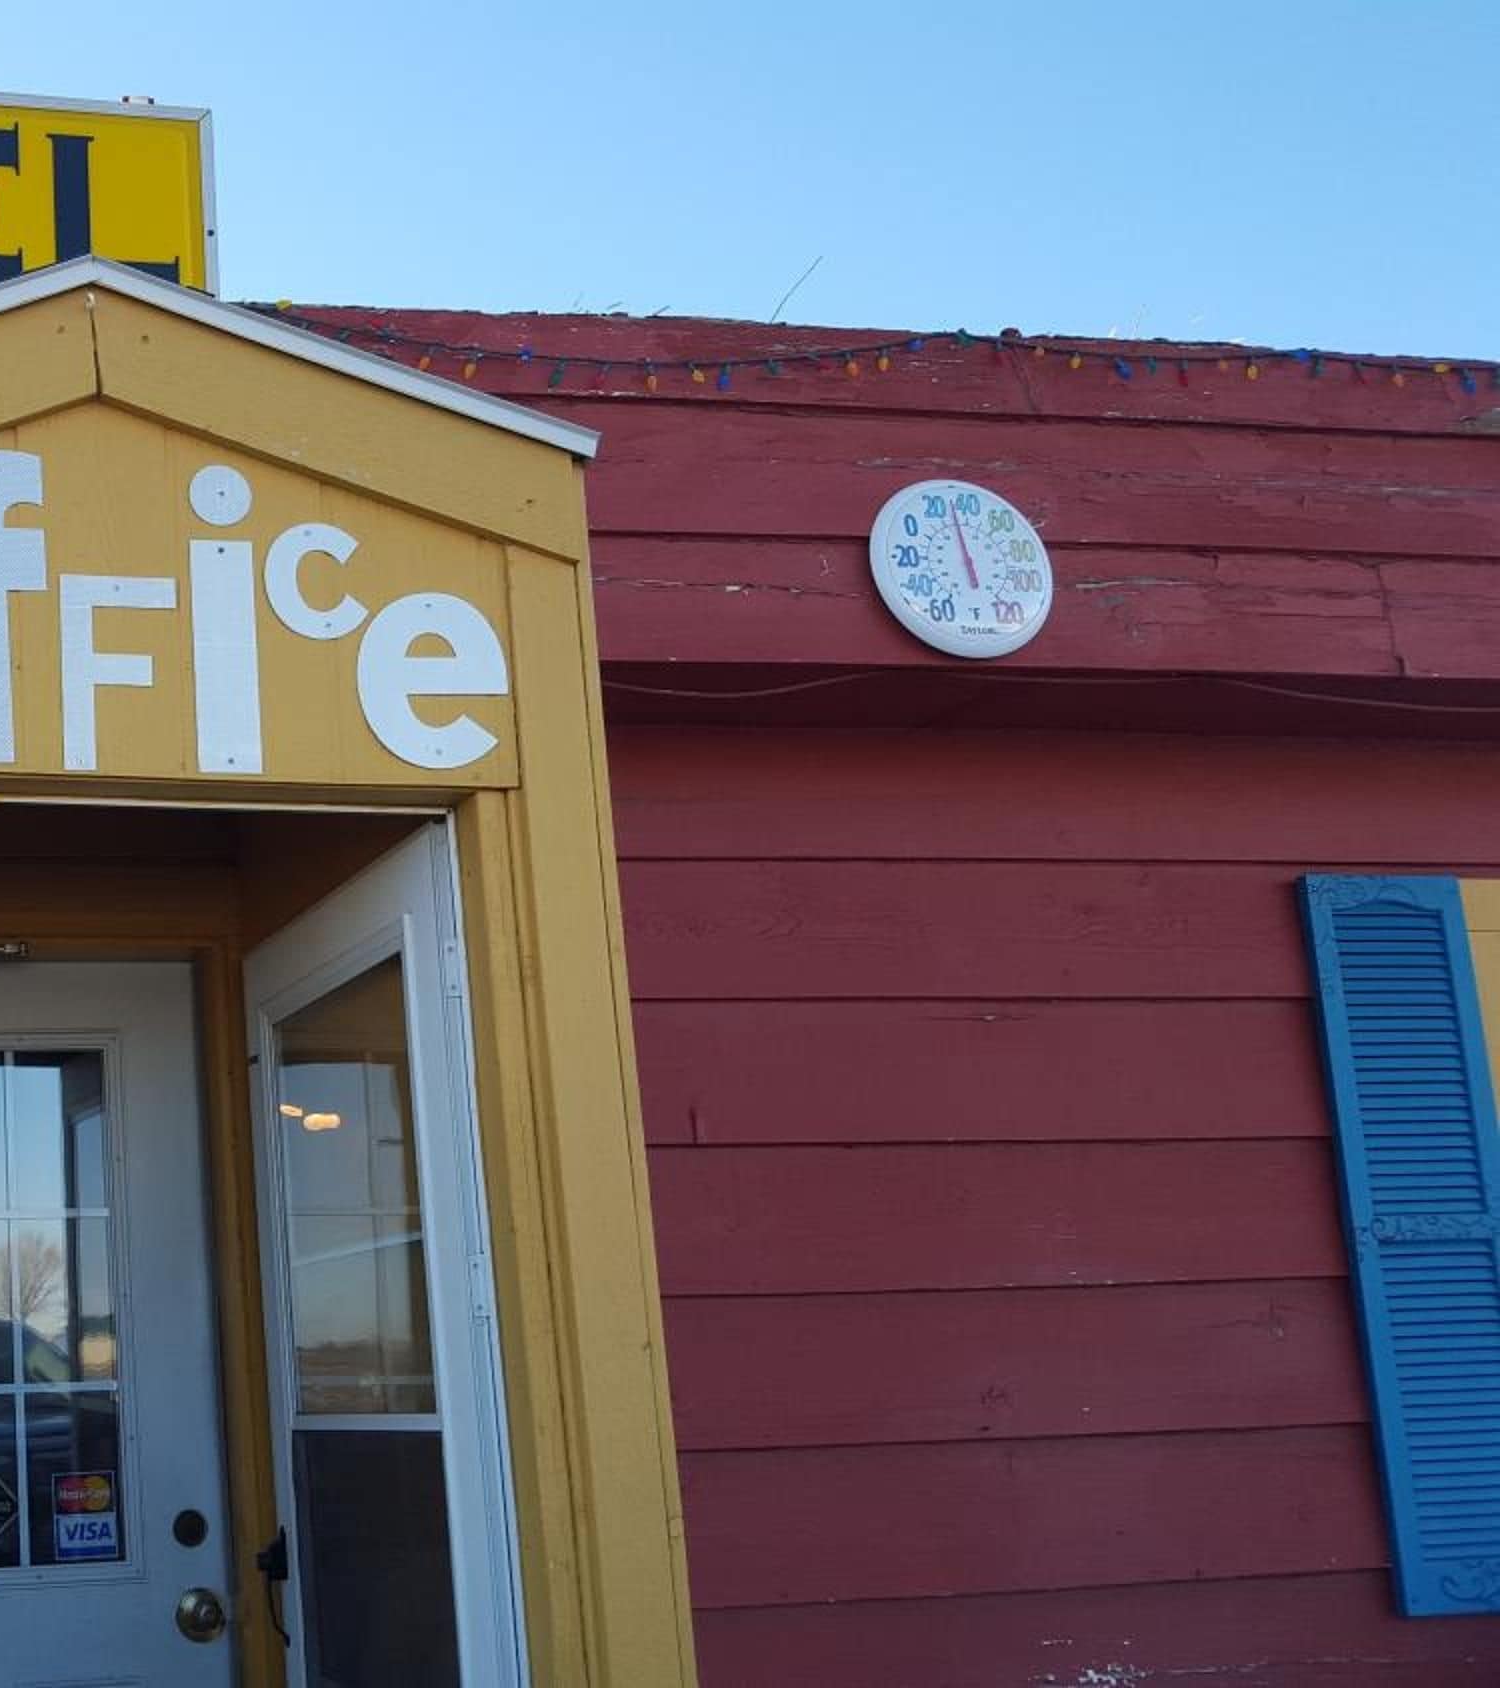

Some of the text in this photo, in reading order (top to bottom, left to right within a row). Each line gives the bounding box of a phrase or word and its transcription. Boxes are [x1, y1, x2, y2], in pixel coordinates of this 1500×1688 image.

[922, 494, 946, 518] 20
[956, 493, 980, 516] 40
[904, 513, 918, 537] 0
[988, 509, 1015, 532] 60
[891, 545, 920, 568] -20
[1009, 539, 1036, 562] 80
[1007, 569, 1043, 593] 100
[924, 599, 955, 622] -60
[991, 601, 1025, 624] 120
[65, 1521, 112, 1541] VISA
